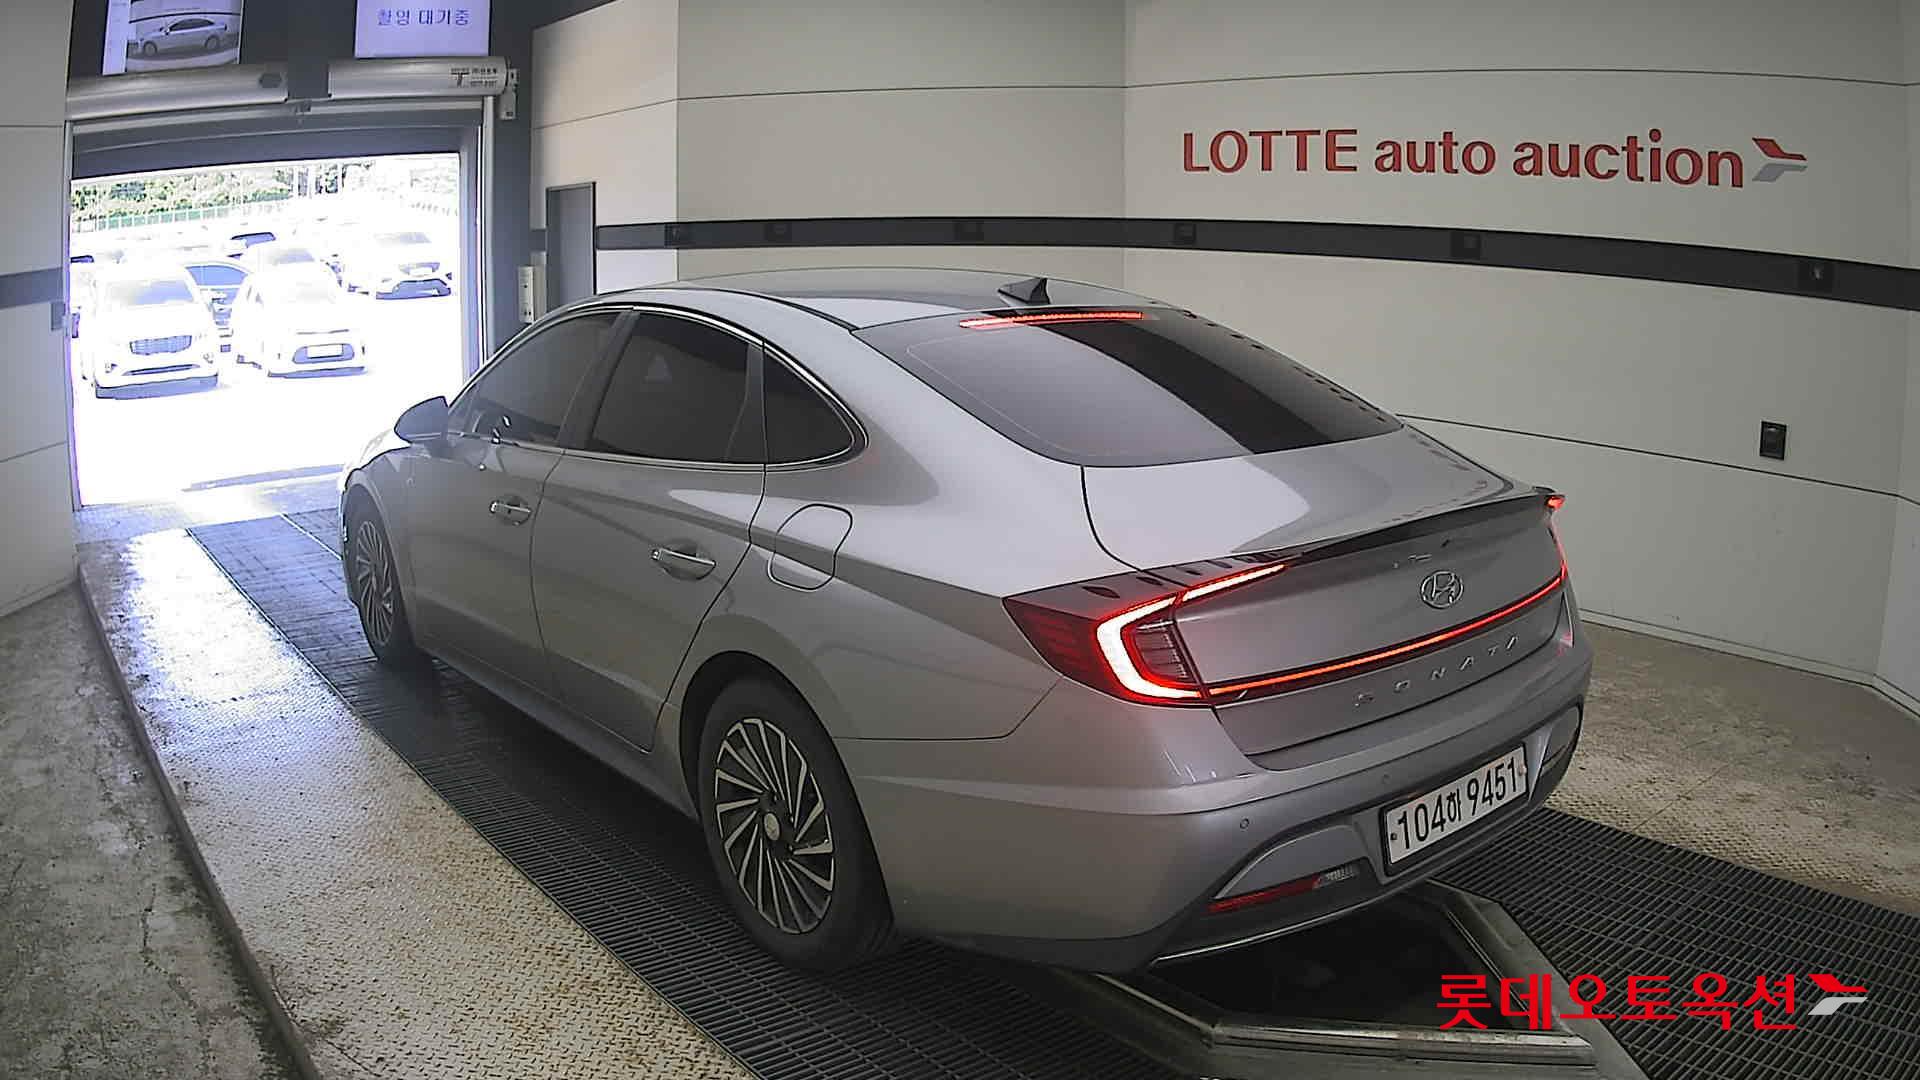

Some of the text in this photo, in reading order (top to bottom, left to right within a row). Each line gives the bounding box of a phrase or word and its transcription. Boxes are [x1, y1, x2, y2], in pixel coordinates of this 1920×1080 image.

[418, 8, 471, 26] 대기중
[1183, 128, 1744, 189] LOTTE auto auction
[1397, 755, 1519, 851] 104하 9451
